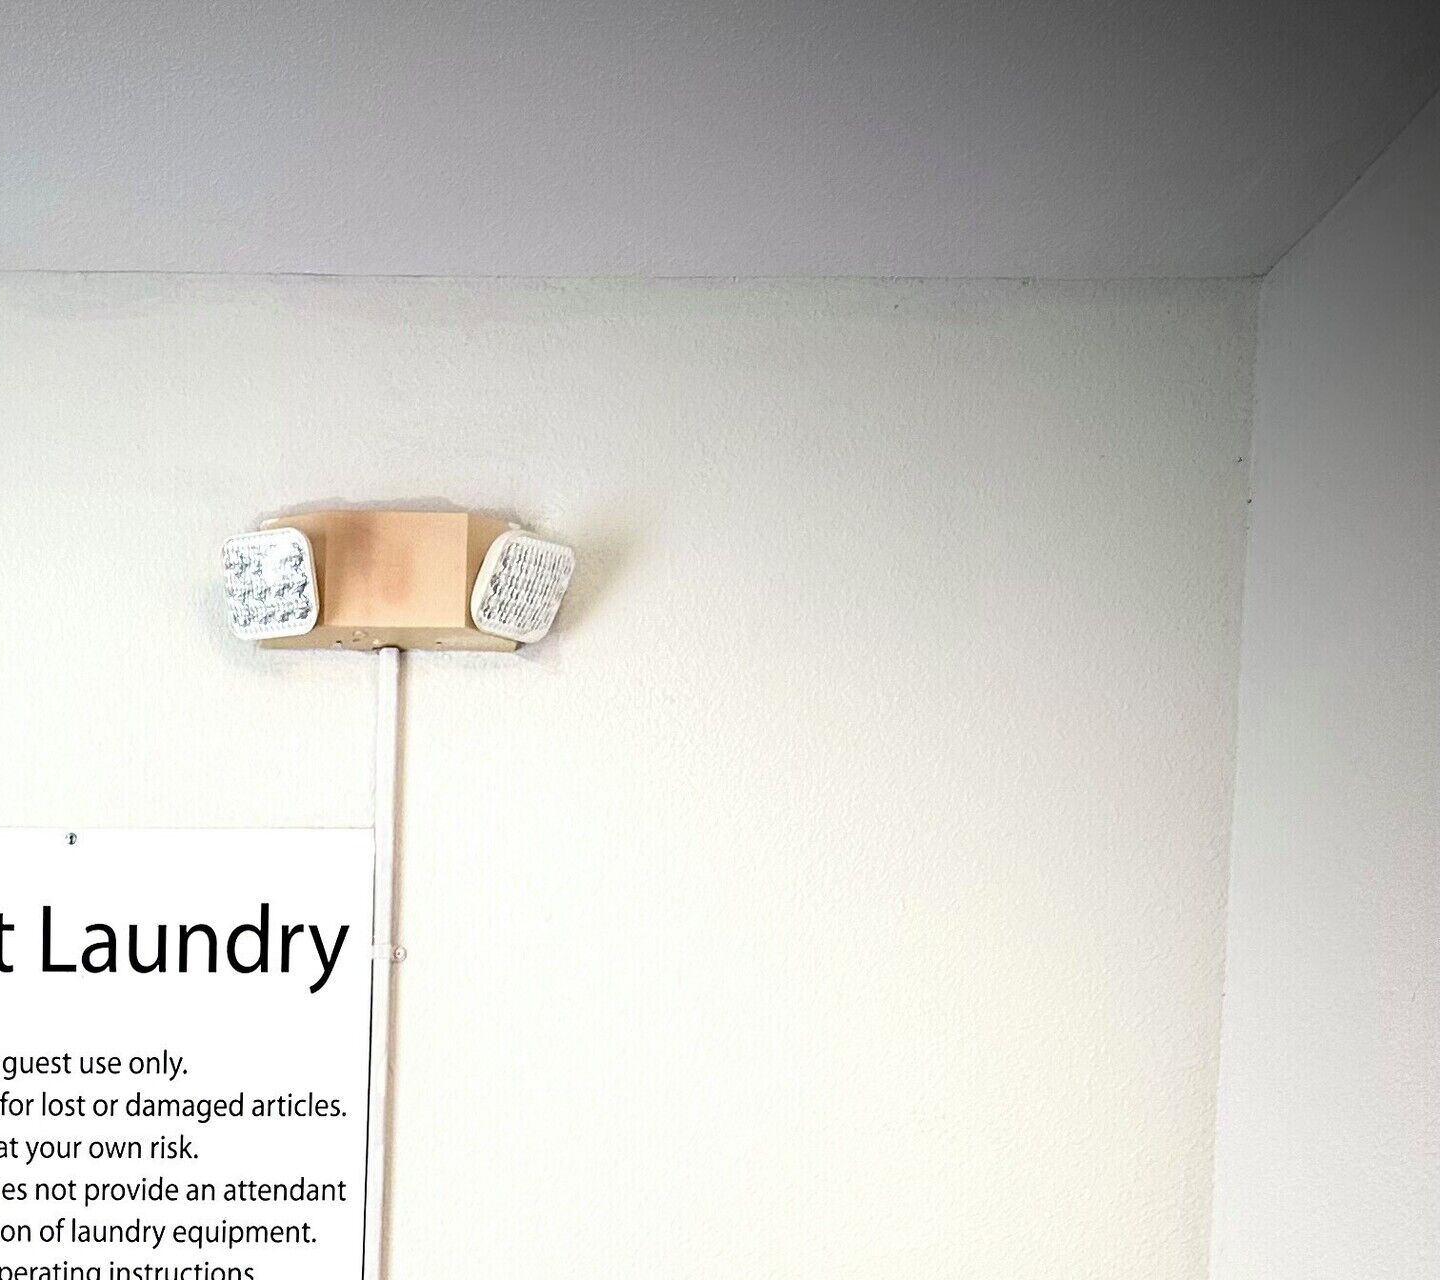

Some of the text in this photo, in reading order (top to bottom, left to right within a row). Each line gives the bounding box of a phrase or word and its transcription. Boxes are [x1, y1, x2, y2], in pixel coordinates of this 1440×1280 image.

[41, 902, 350, 995] Laundry
[2, 1052, 72, 1081] guest
[79, 1056, 122, 1075] use
[128, 1048, 188, 1082] only.
[0, 1090, 35, 1117] for
[42, 1091, 86, 1117] lost
[92, 1098, 119, 1117] or
[125, 1091, 244, 1124] damaged
[251, 1091, 347, 1117] articles.
[25, 1140, 83, 1166] your
[88, 1141, 142, 1159] own
[150, 1133, 199, 1160] risk.
[35, 1179, 77, 1201] not
[84, 1175, 179, 1208] provide
[186, 1183, 216, 1202] an
[223, 1176, 347, 1202] attendant
[39, 1217, 66, 1243] of
[71, 1217, 166, 1250] laundry
[172, 1219, 317, 1250] equipment.
